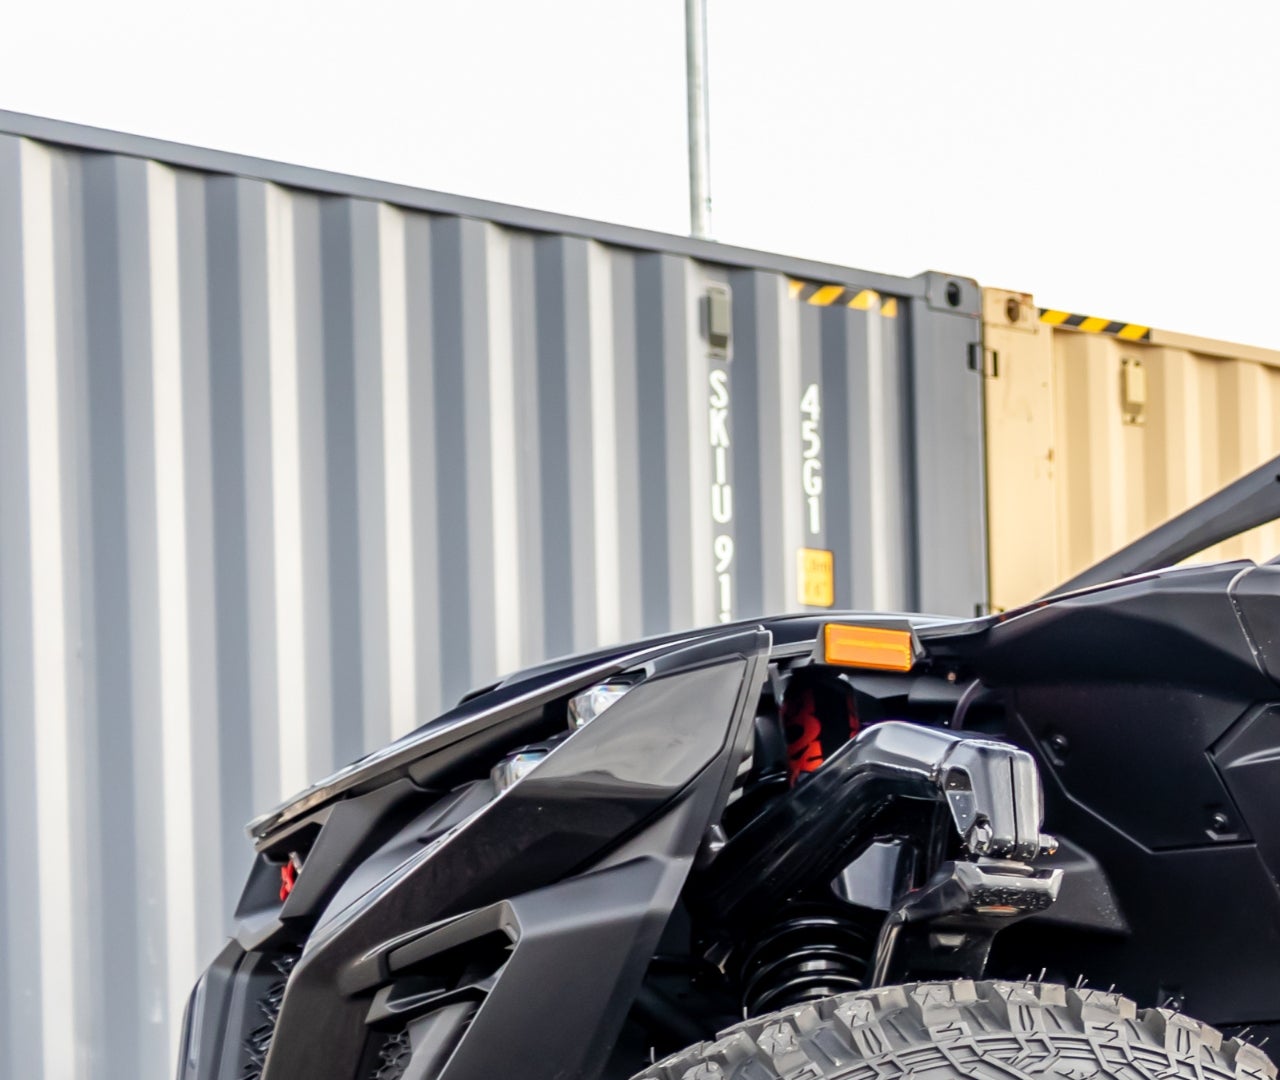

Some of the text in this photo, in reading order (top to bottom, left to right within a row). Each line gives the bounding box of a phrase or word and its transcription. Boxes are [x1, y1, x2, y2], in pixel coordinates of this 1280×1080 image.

[708, 368, 735, 623] SKIU 91
[800, 383, 823, 535] 45G1
